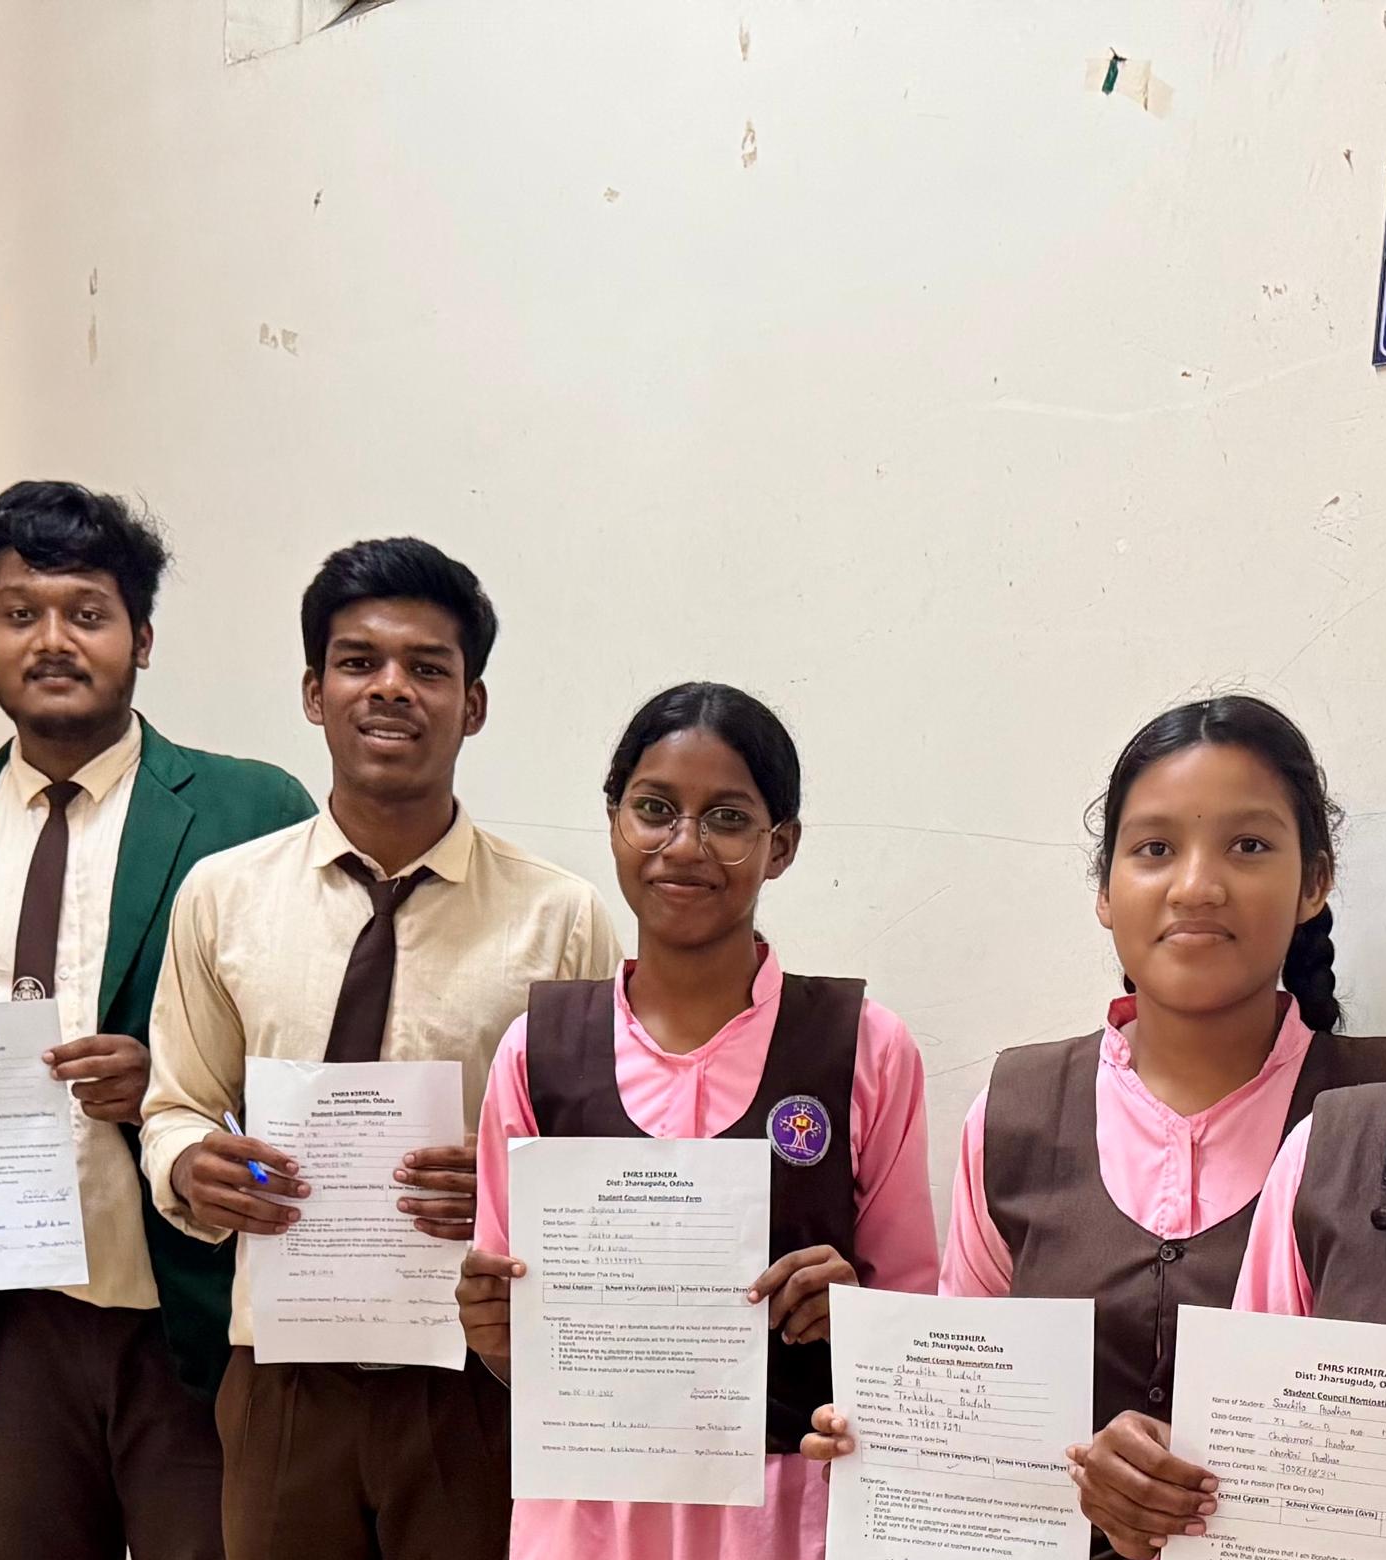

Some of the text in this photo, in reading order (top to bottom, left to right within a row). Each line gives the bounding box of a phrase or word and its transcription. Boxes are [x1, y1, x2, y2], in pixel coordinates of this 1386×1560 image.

[1317, 1362, 1344, 1373] EMRS
[1295, 1371, 1316, 1380] Dist:
[1318, 1373, 1376, 1389] Jharsuguda,
[1283, 1388, 1315, 1399] Student
[1317, 1392, 1348, 1403] Council
[1286, 1500, 1309, 1509] School
[1310, 1503, 1325, 1511] Vice
[1326, 1505, 1354, 1515] Captain
